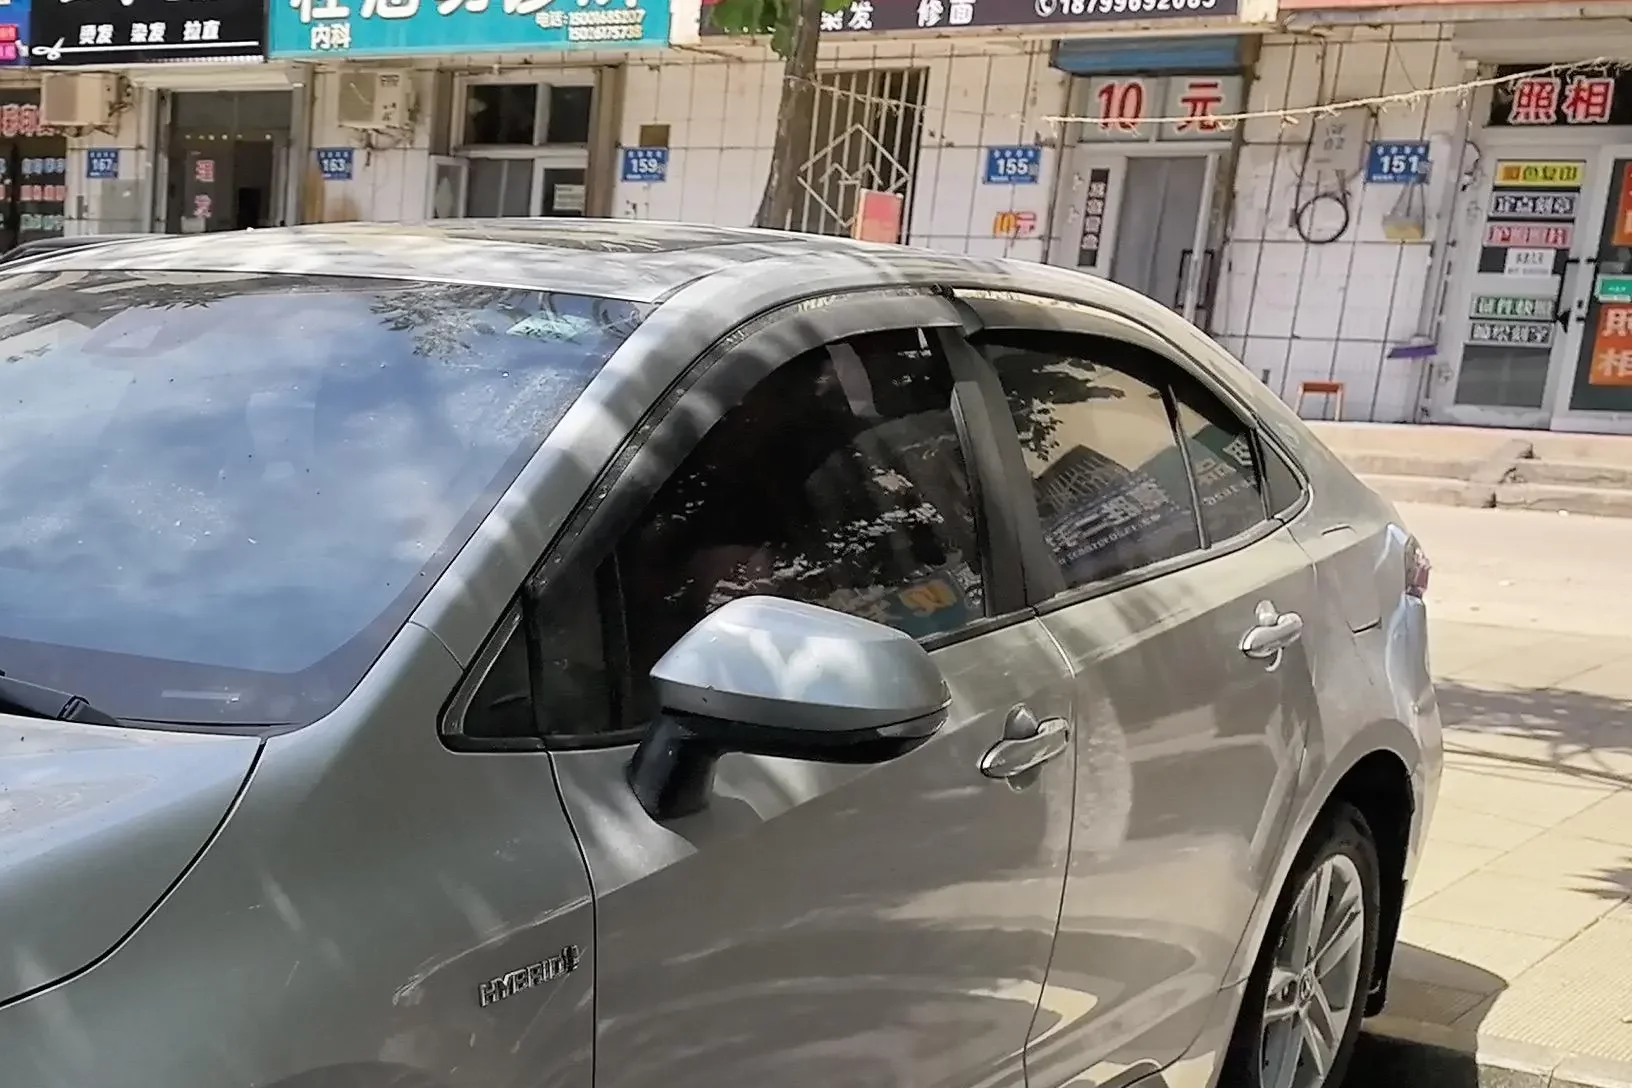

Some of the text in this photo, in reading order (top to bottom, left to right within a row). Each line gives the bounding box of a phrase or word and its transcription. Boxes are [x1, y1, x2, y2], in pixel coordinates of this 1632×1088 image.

[918, 0, 974, 27] 修面
[130, 22, 166, 43] 染发
[311, 23, 352, 51] 内科
[1098, 81, 1224, 132] 10 元
[1509, 77, 1615, 124] 照相
[92, 158, 113, 171] 167
[322, 158, 346, 172] 163
[631, 157, 658, 173] 159
[997, 158, 1029, 175] 155
[1380, 155, 1420, 173] 151
[479, 955, 567, 1007] HYBRID
